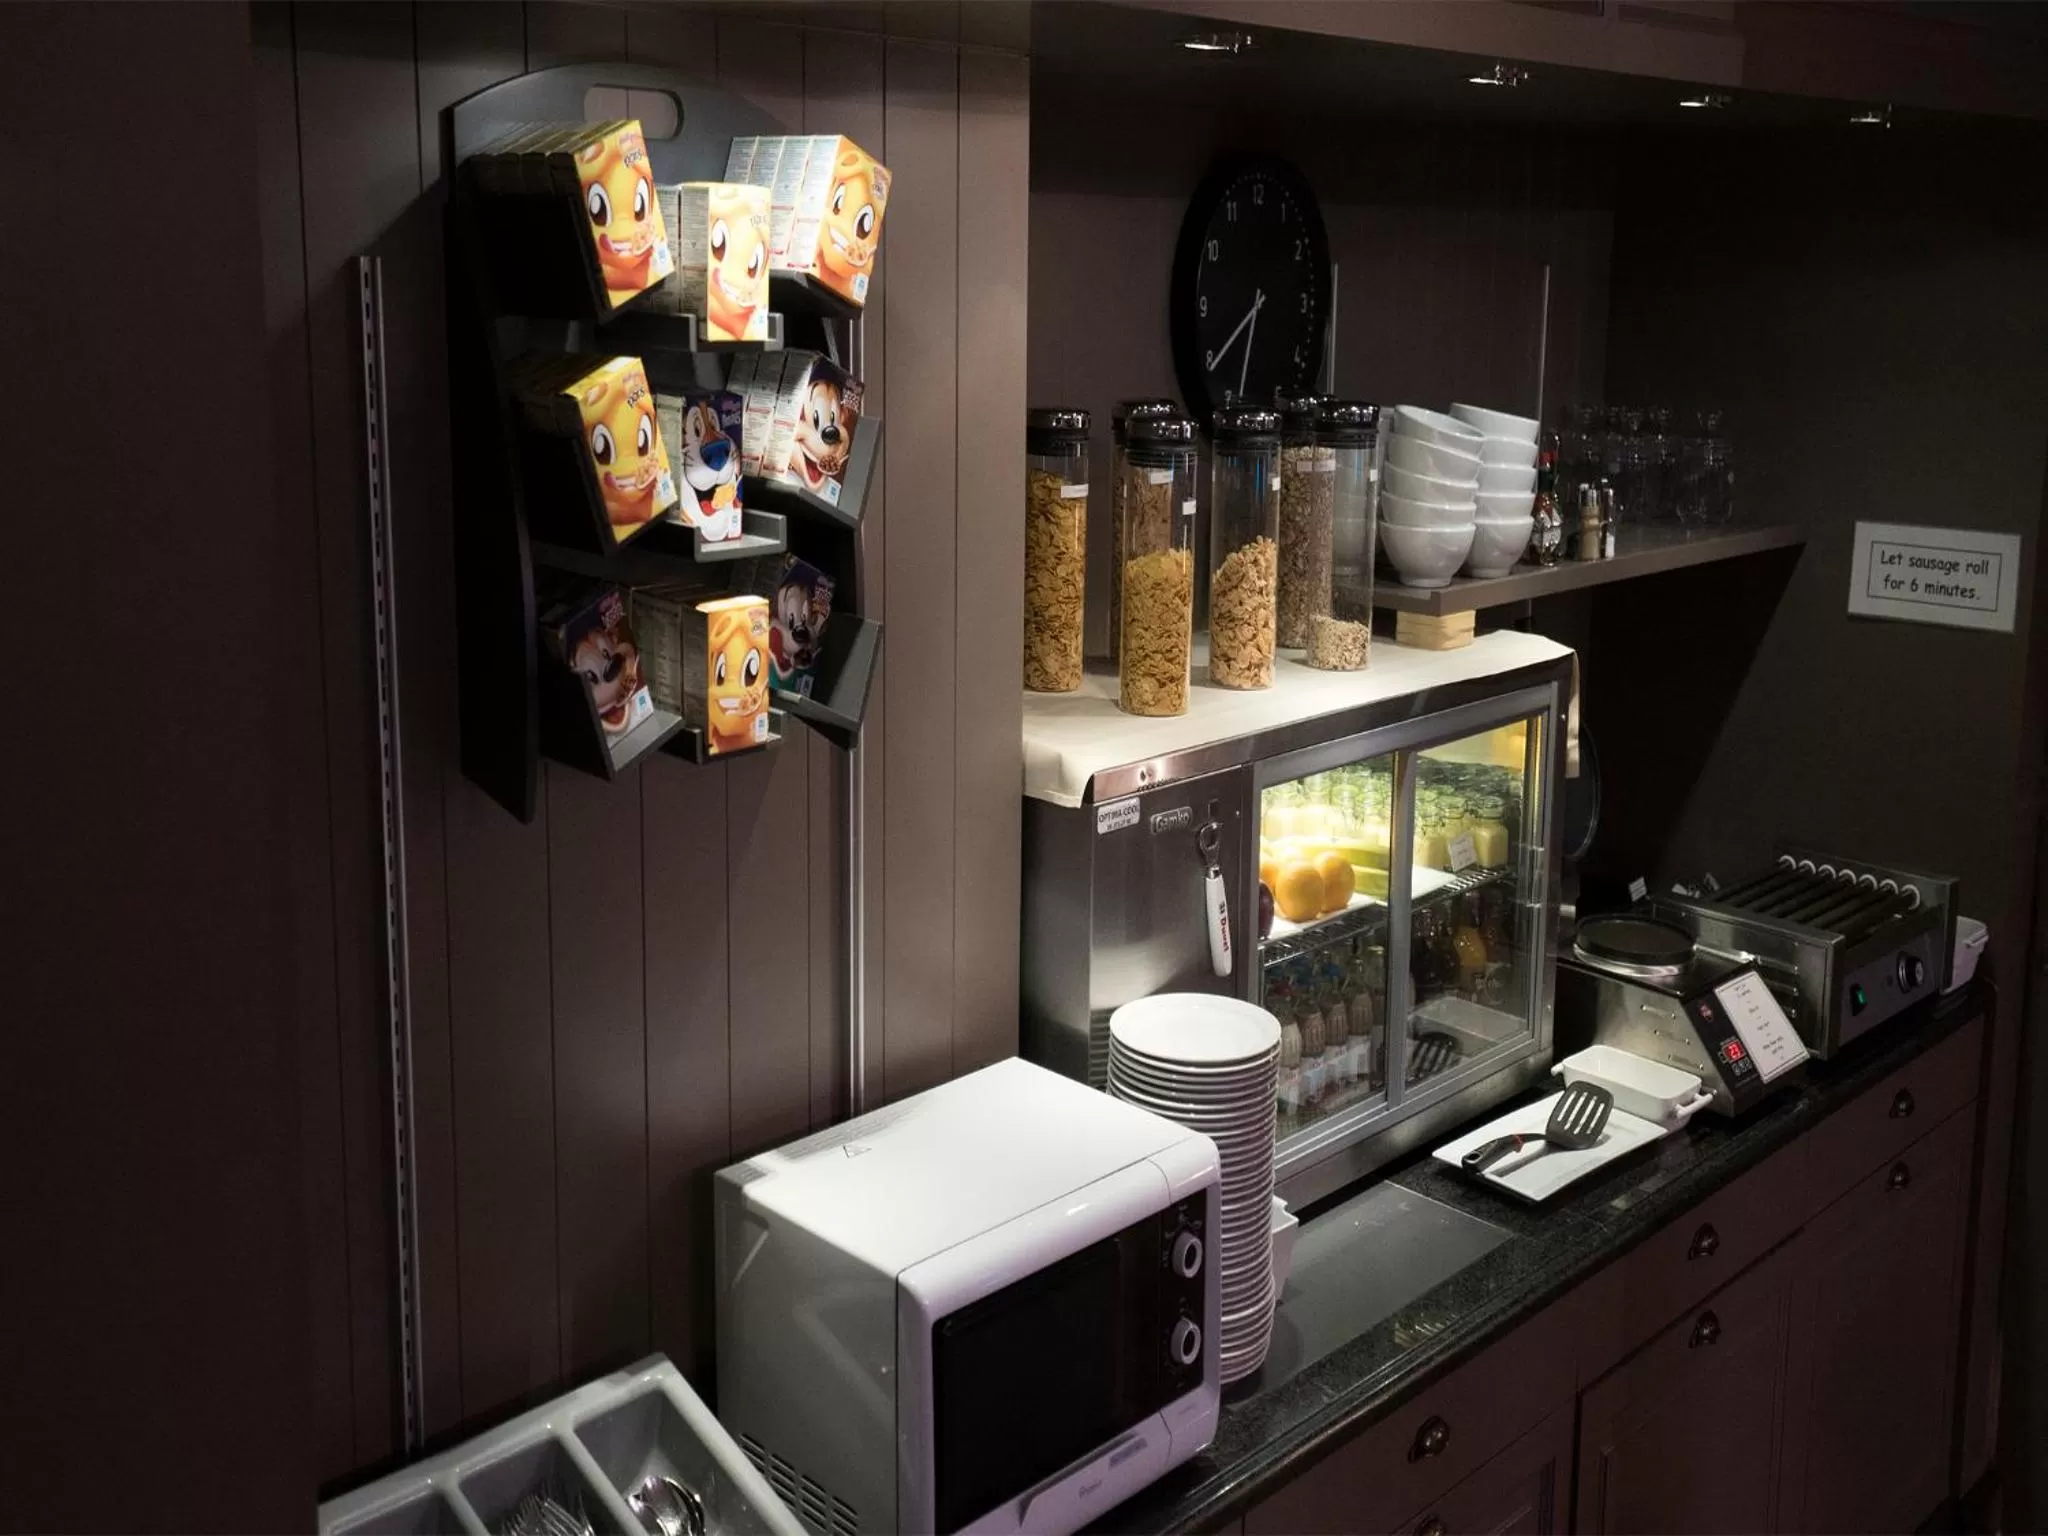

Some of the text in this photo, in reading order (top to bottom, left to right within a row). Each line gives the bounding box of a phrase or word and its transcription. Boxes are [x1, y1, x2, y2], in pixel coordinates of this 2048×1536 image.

[1252, 183, 1265, 205] 12
[1226, 201, 1238, 222] 11
[1281, 201, 1287, 223] 1
[1207, 240, 1220, 262] 10
[1294, 240, 1303, 260] 2
[1199, 296, 1208, 318] 9
[1299, 292, 1308, 315] 3
[1206, 349, 1214, 371] 8
[1881, 549, 1990, 576] Let sausage roll
[1882, 573, 1981, 600] for 6 minutes.
